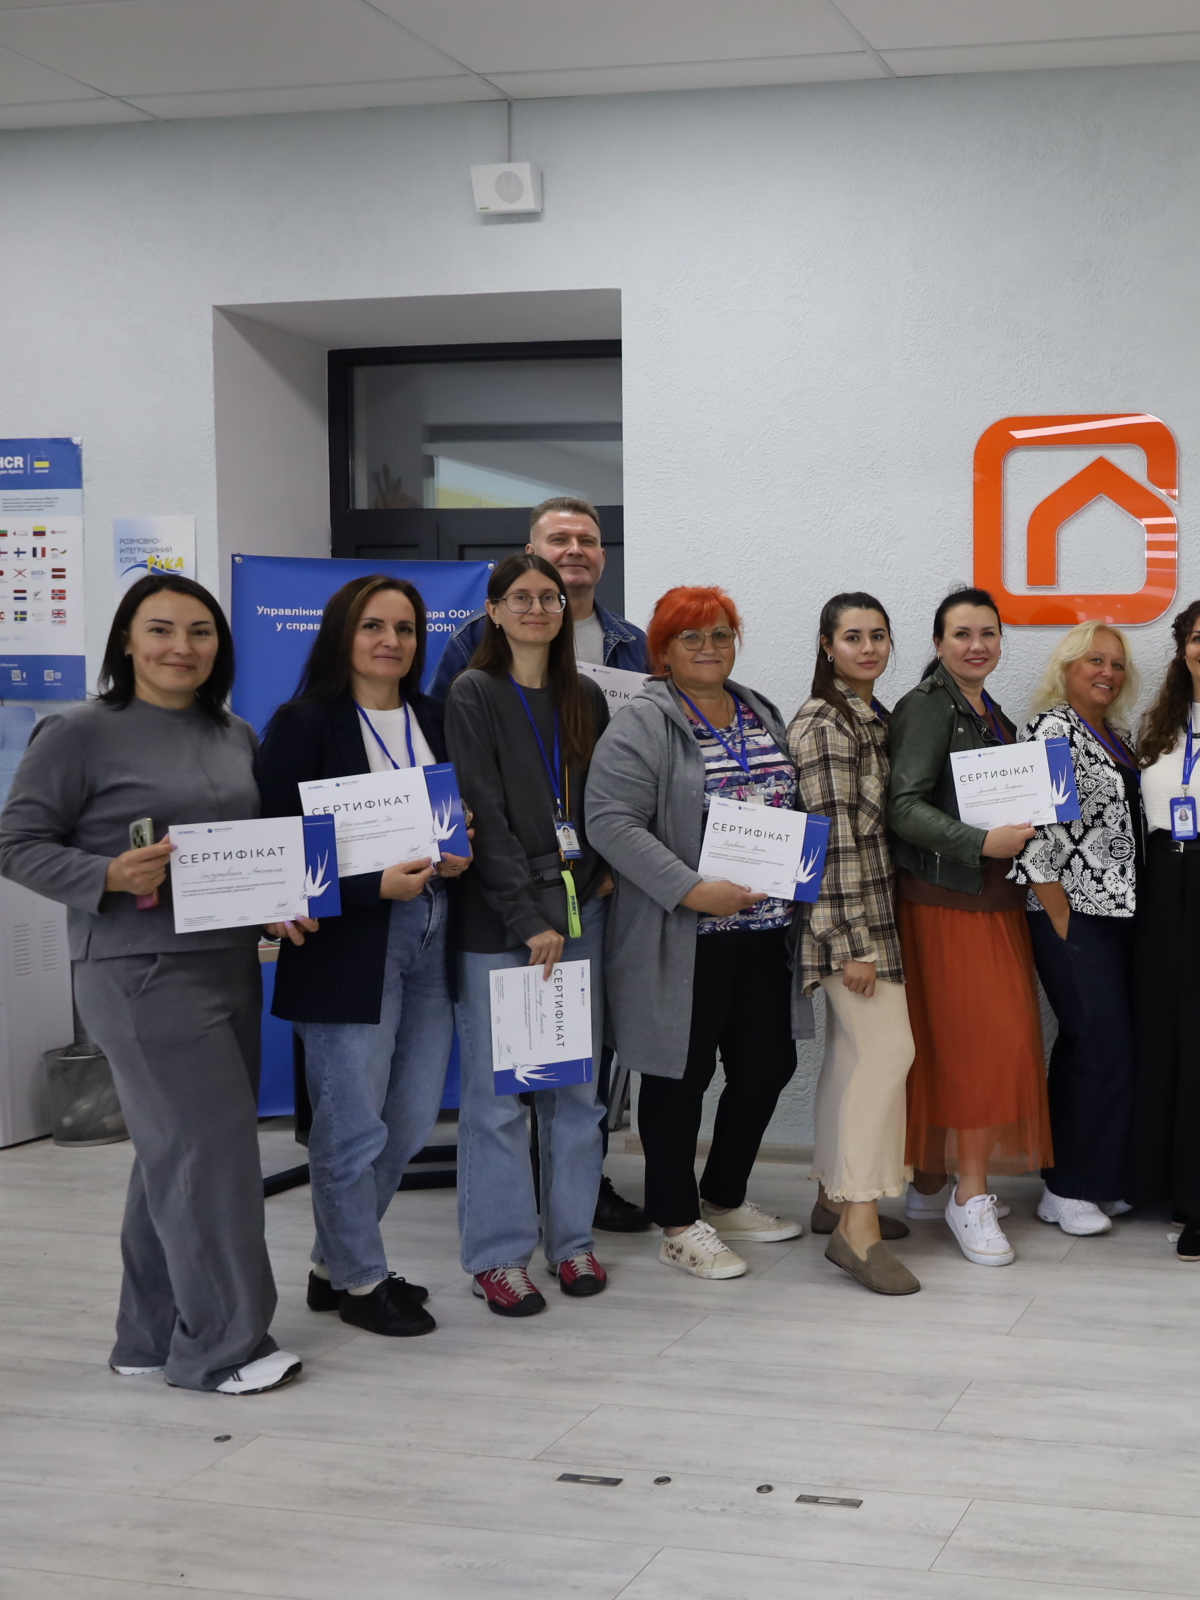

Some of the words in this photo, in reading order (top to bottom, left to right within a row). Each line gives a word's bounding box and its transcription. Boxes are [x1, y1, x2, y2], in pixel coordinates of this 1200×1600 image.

[119, 556, 138, 564] КЛУБ
[256, 605, 324, 618] Управління
[426, 612, 445, 620] ара
[276, 622, 283, 631] у
[286, 622, 321, 632] справ
[959, 765, 1035, 783] СЕРТИФІКАТ
[311, 794, 411, 816] СЕРТИФІКАТ
[712, 822, 791, 842] СЕРТИФІКАТ
[179, 846, 286, 865] СЕРТИФІКАТ
[553, 968, 565, 1048] СЕРТИФІКАТ
